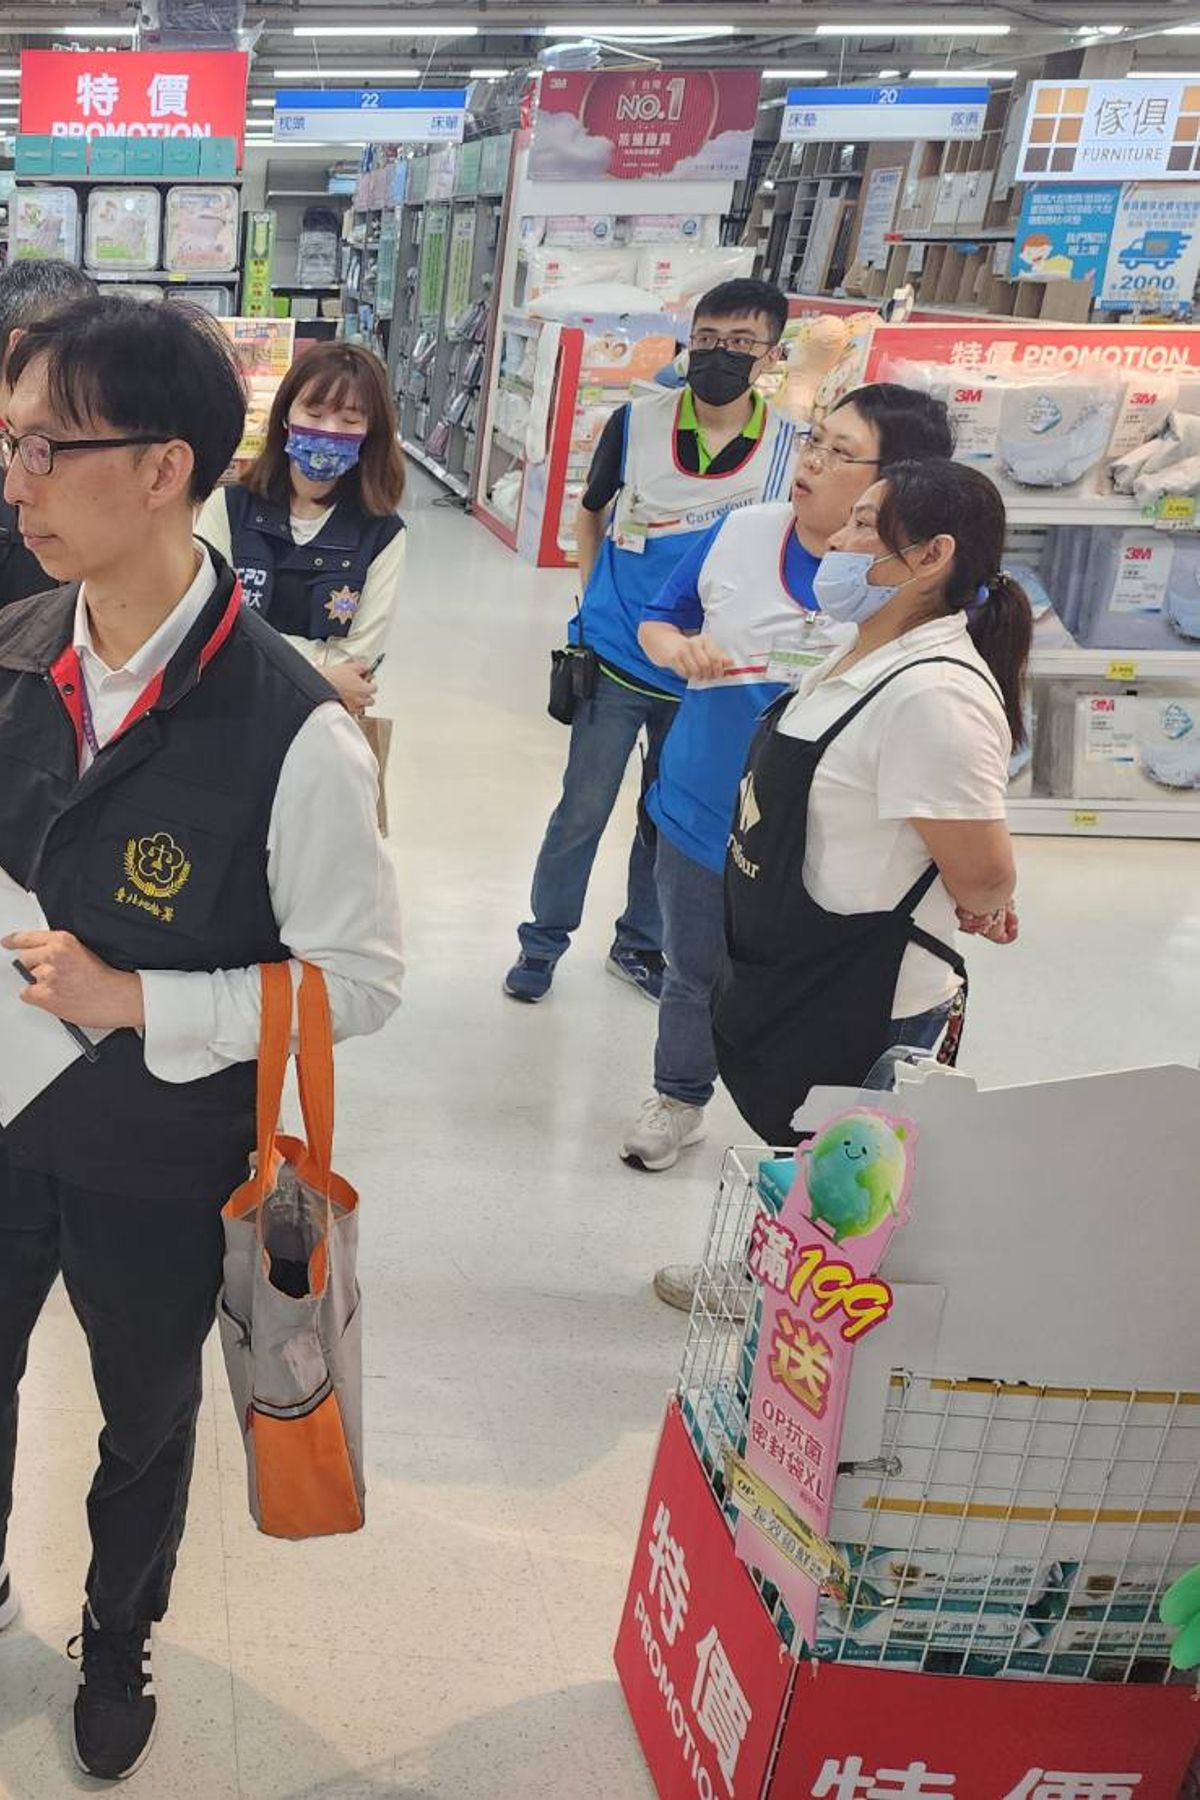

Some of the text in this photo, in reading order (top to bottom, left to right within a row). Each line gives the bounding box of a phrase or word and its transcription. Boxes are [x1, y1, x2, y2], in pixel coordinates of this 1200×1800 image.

[76, 73, 190, 118] 特價
[361, 93, 379, 108] 22
[879, 89, 898, 104] 20
[1094, 97, 1170, 136] 傢俱
[52, 122, 212, 138] PROMOTION
[1081, 146, 1164, 162] FURNITURE
[1022, 345, 1191, 369] PROMOTION
[955, 389, 983, 403] 3M
[1130, 392, 1158, 405] 3M
[1124, 547, 1153, 560] 3M
[1091, 699, 1115, 712] 3M
[769, 1310, 832, 1419] 送
[762, 1399, 824, 1466] OP抗菌
[751, 1420, 825, 1501] 密封袋XL
[649, 1501, 753, 1798] 特價
[634, 1592, 717, 1800] PROMOTIO
